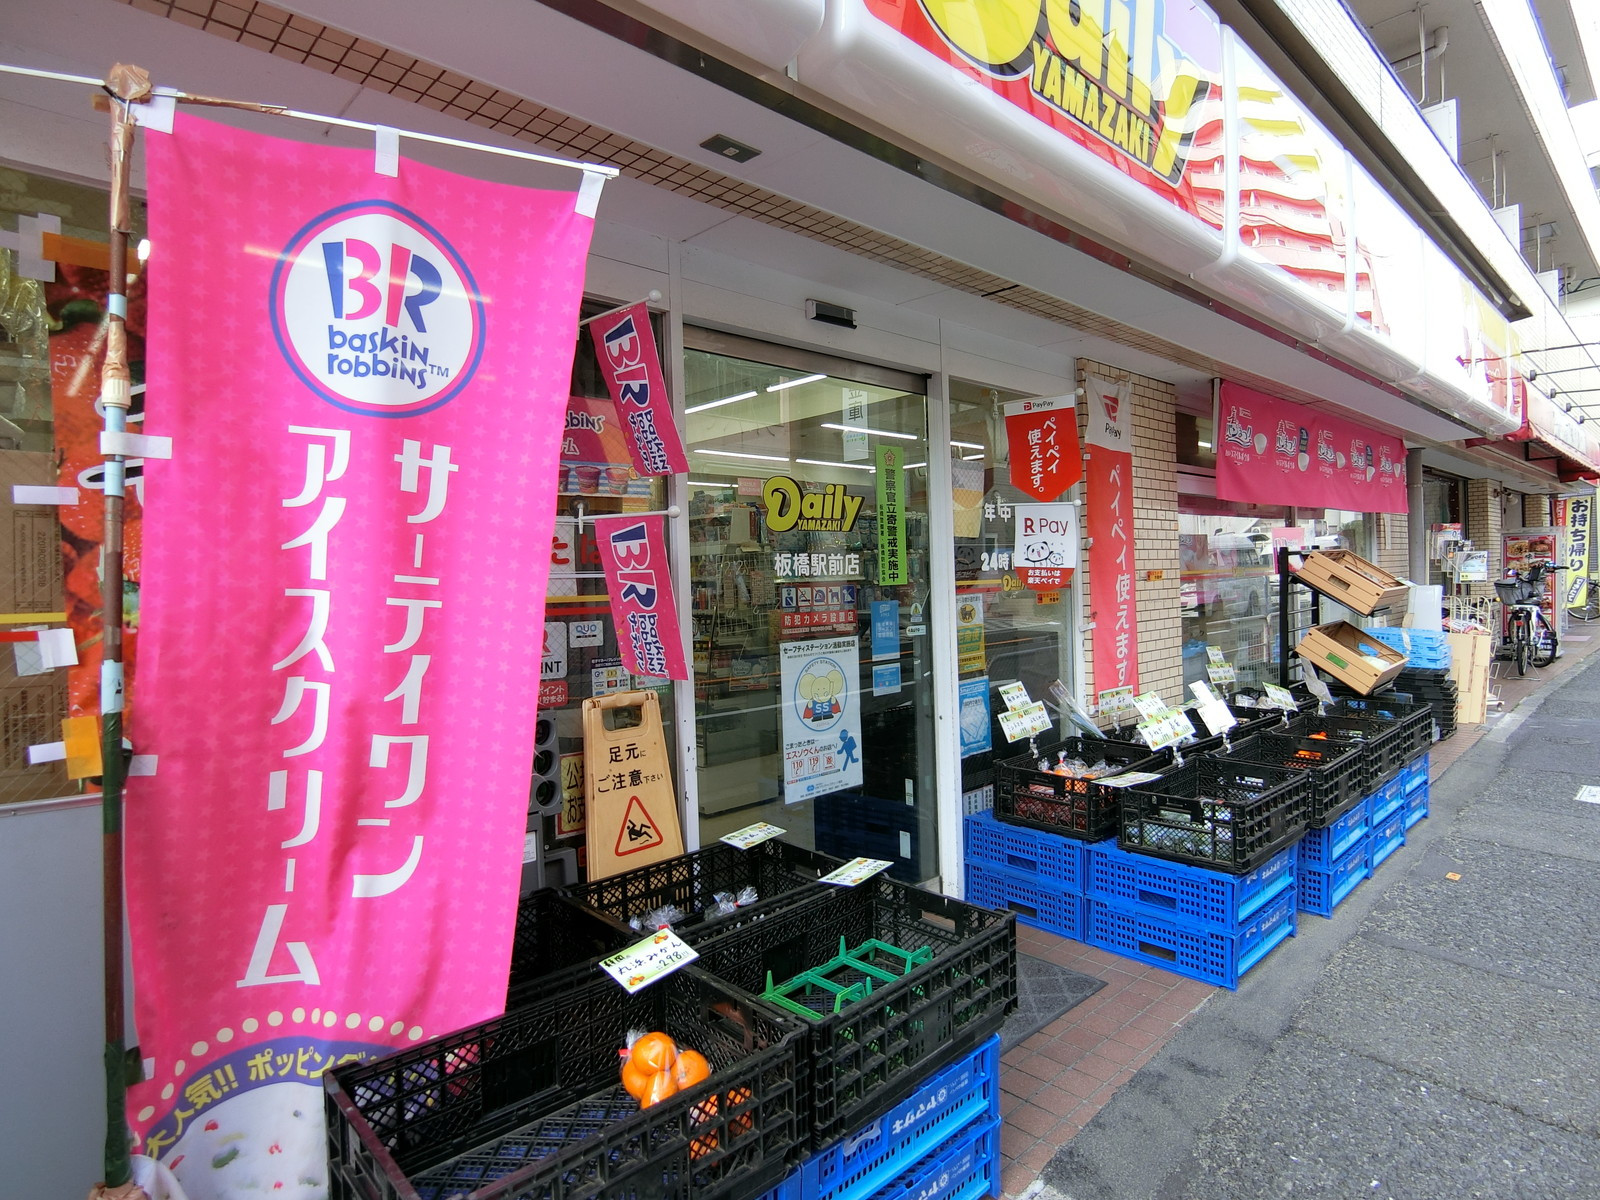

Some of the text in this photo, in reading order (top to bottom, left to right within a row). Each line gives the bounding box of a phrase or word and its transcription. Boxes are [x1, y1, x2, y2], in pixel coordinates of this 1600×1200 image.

[1032, 39, 1152, 164] YAMAZAKI
[322, 238, 443, 333] BR
[328, 325, 429, 366] baskin
[604, 314, 650, 407] BR
[328, 353, 427, 389] robbins
[1032, 400, 1054, 409] PayPay
[1028, 428, 1044, 493] 使えます。
[1043, 416, 1060, 474] ペイペイ
[763, 475, 866, 532] Daily
[797, 519, 841, 532] YAMAZAKI
[1040, 517, 1069, 537] Pay
[1569, 499, 1588, 572] お持ち帰り
[610, 522, 658, 610] BR
[774, 552, 860, 577] 板橋駅前店
[1027, 577, 1061, 585] 楽天ペイで
[1028, 569, 1061, 577] お支払いは
[1109, 464, 1130, 686] ペイペイ使えます
[576, 624, 597, 634] QUO
[353, 438, 459, 897] サーティワン
[236, 424, 351, 988] アイスクリーム
[815, 702, 830, 713] SS
[609, 743, 647, 764] 足元に
[598, 769, 664, 793] ご注意下さい
